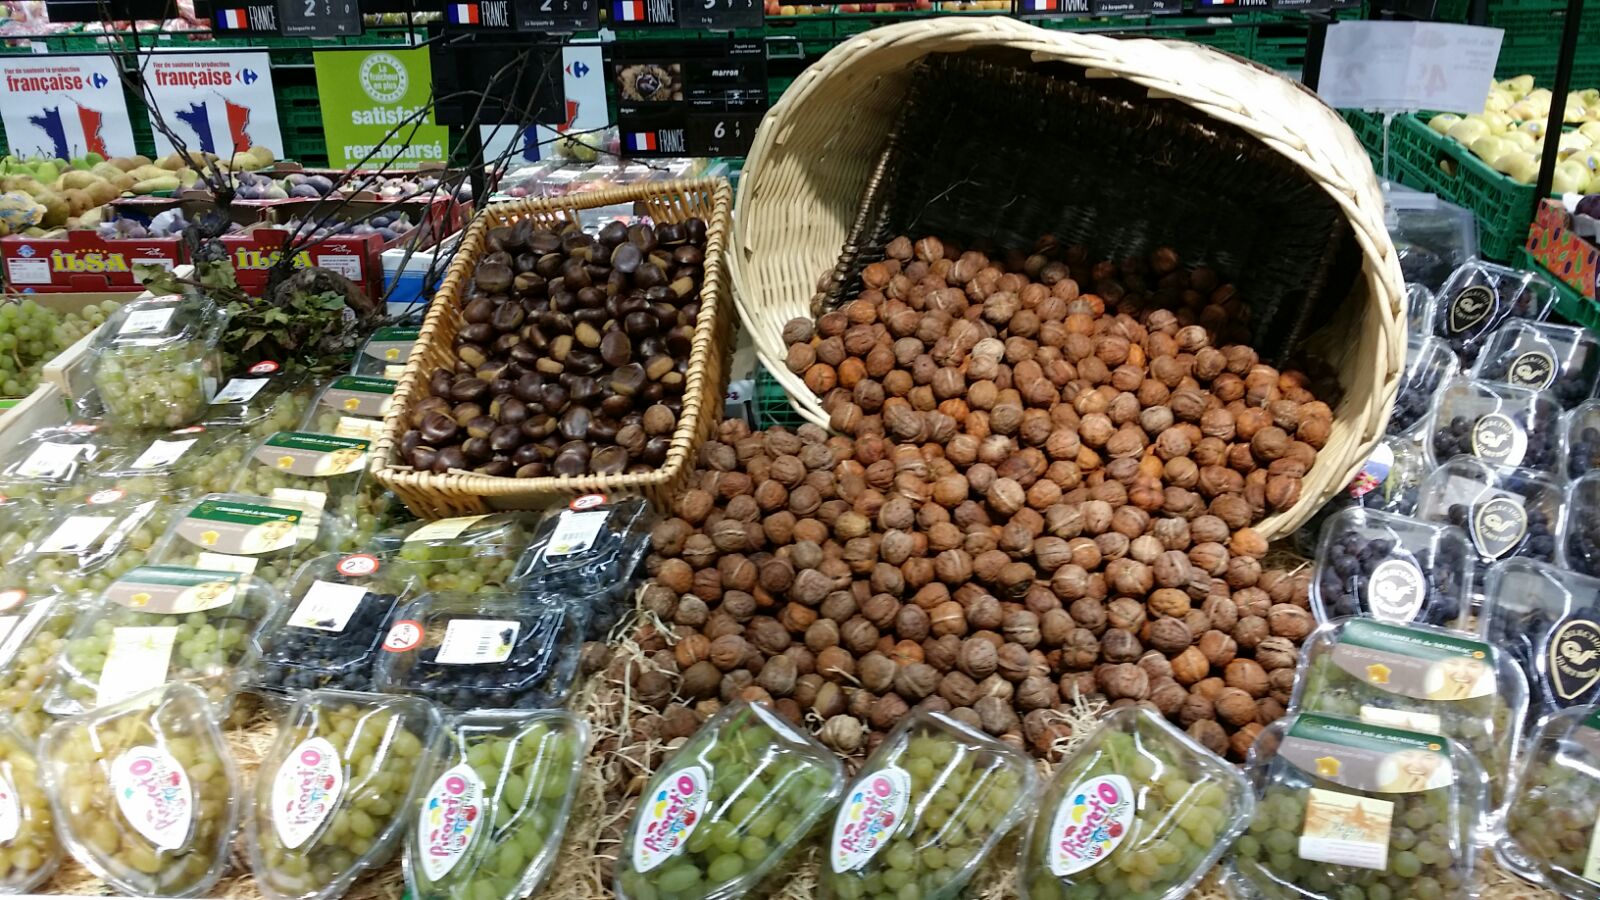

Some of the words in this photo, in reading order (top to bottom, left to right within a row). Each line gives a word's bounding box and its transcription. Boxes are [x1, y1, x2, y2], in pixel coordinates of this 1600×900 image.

[304, 0, 316, 16] 2
[481, 1, 509, 27] FRANCE
[648, 0, 675, 23] FRANCE
[248, 5, 277, 31] FRANCE
[7, 74, 83, 94] française
[155, 69, 232, 88] française
[352, 106, 429, 125] satisfait
[714, 122, 725, 138] 6
[344, 141, 442, 159] remboursé
[659, 129, 686, 152] FRANCE
